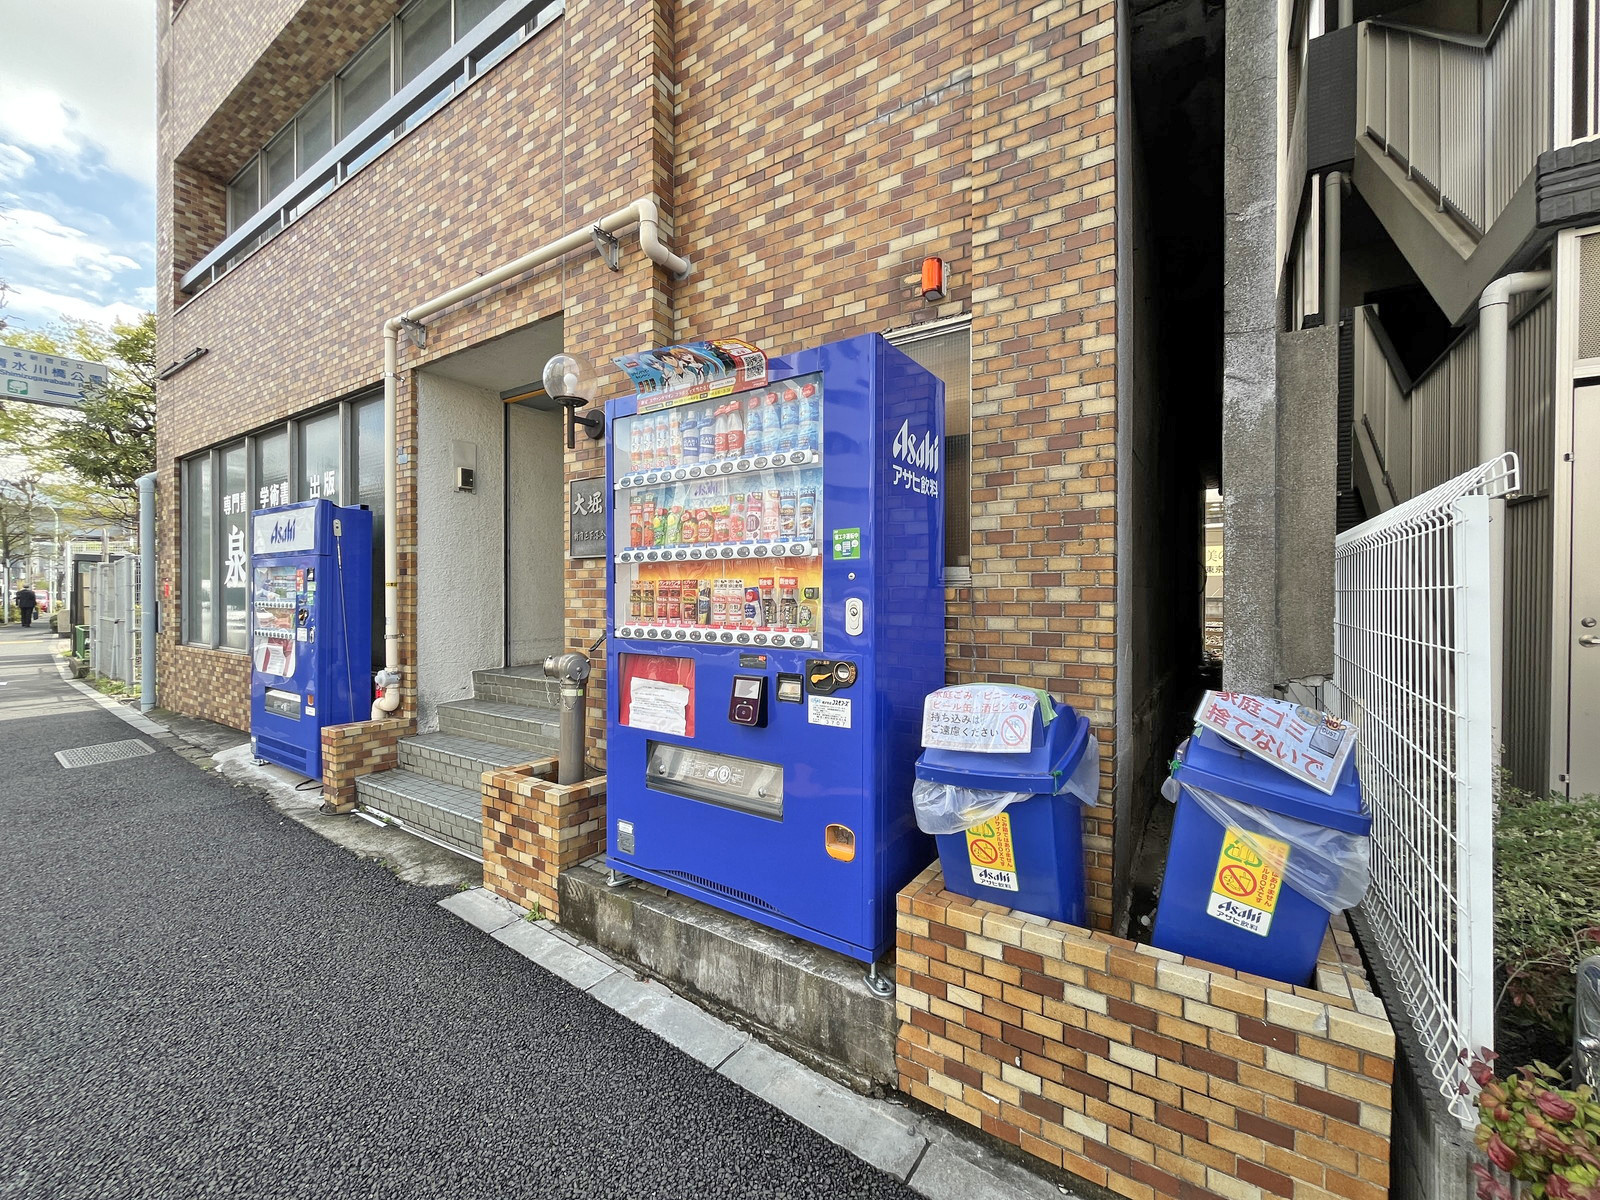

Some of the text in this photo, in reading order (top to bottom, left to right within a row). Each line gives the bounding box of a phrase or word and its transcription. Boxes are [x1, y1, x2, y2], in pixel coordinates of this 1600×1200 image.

[893, 419, 939, 474] Asahi
[223, 470, 336, 515] 専門書 学術書 出版
[893, 464, 939, 498] アサヒ飲料
[572, 491, 603, 516] 大堀
[270, 518, 296, 545] Asahi
[930, 724, 999, 737] ご遠慮ください
[1321, 726, 1338, 739] DUST
[1325, 717, 1339, 728] NO
[1205, 703, 1325, 779] 捨てないで
[979, 869, 1010, 883] Asahi
[1216, 910, 1259, 932] アサヒ飲料
[1217, 901, 1263, 924] Asahi
